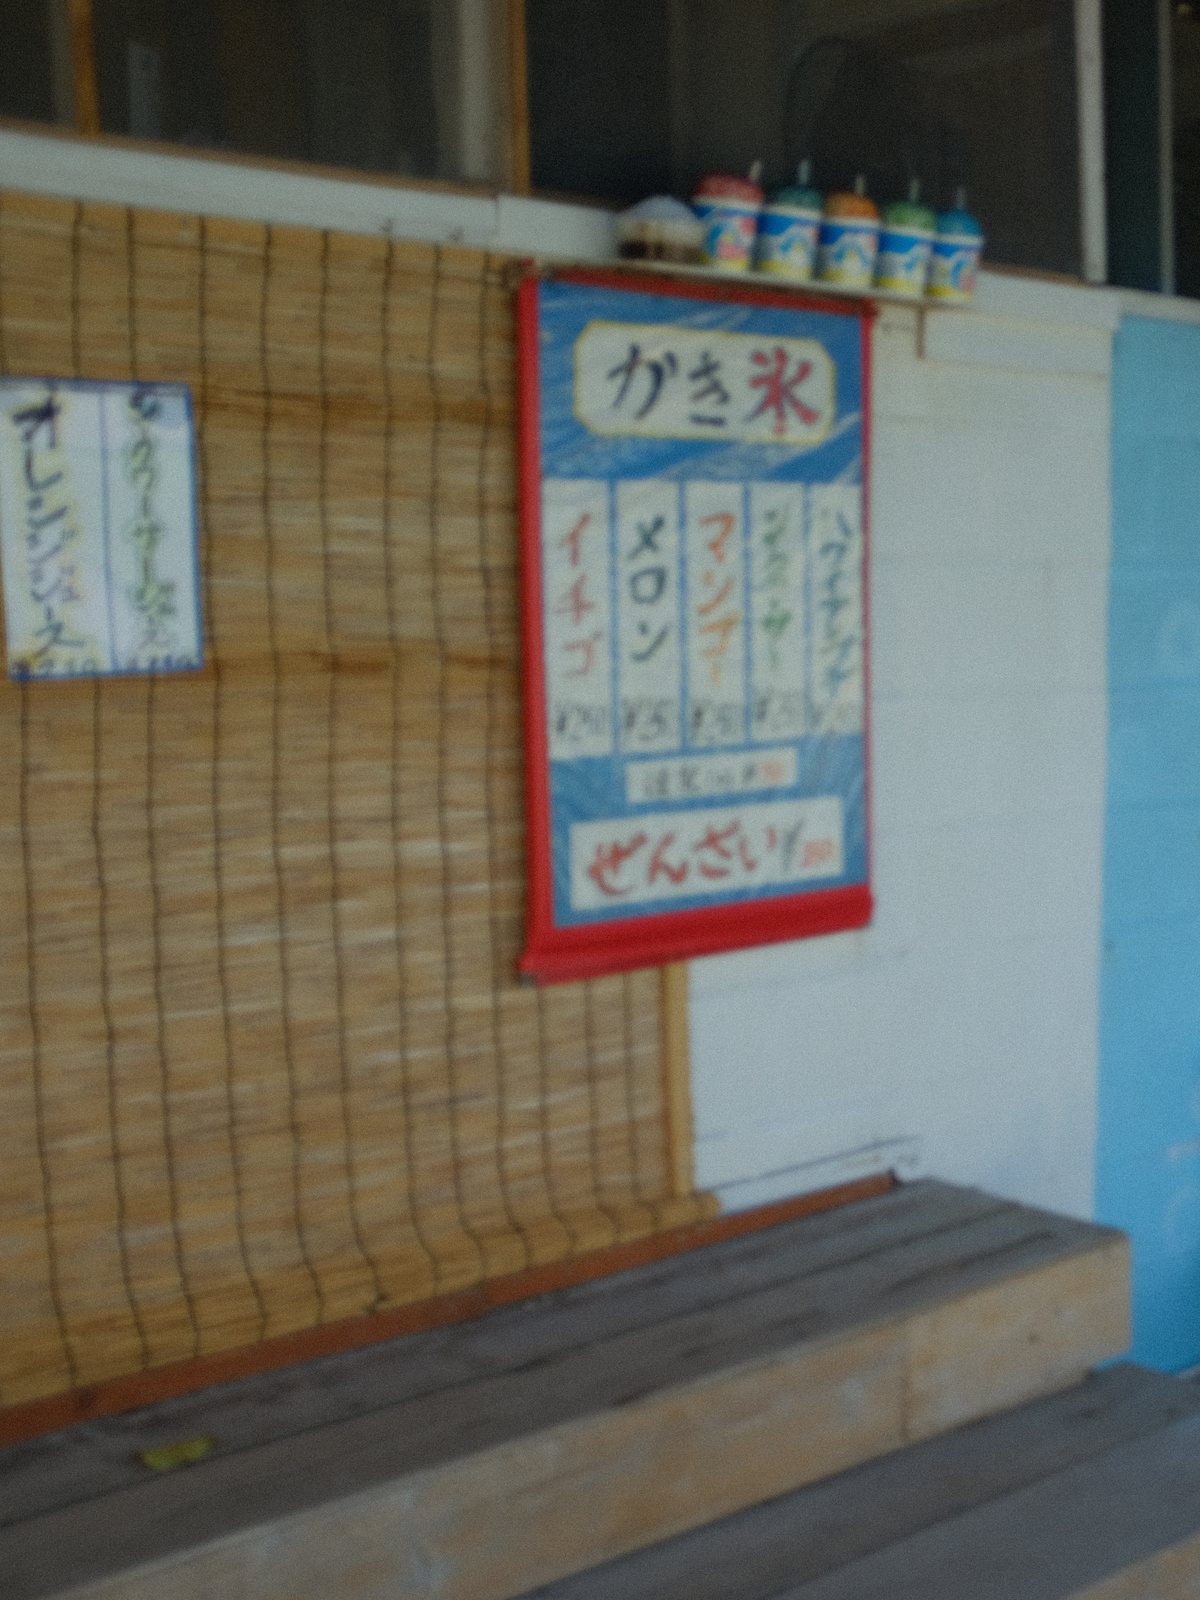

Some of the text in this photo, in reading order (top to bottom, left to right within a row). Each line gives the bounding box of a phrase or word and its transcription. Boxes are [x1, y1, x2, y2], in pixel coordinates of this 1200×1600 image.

[607, 341, 820, 435] かき氷
[556, 513, 601, 678] イチゴ
[627, 515, 670, 663] メロン
[697, 513, 740, 686] マンゴー
